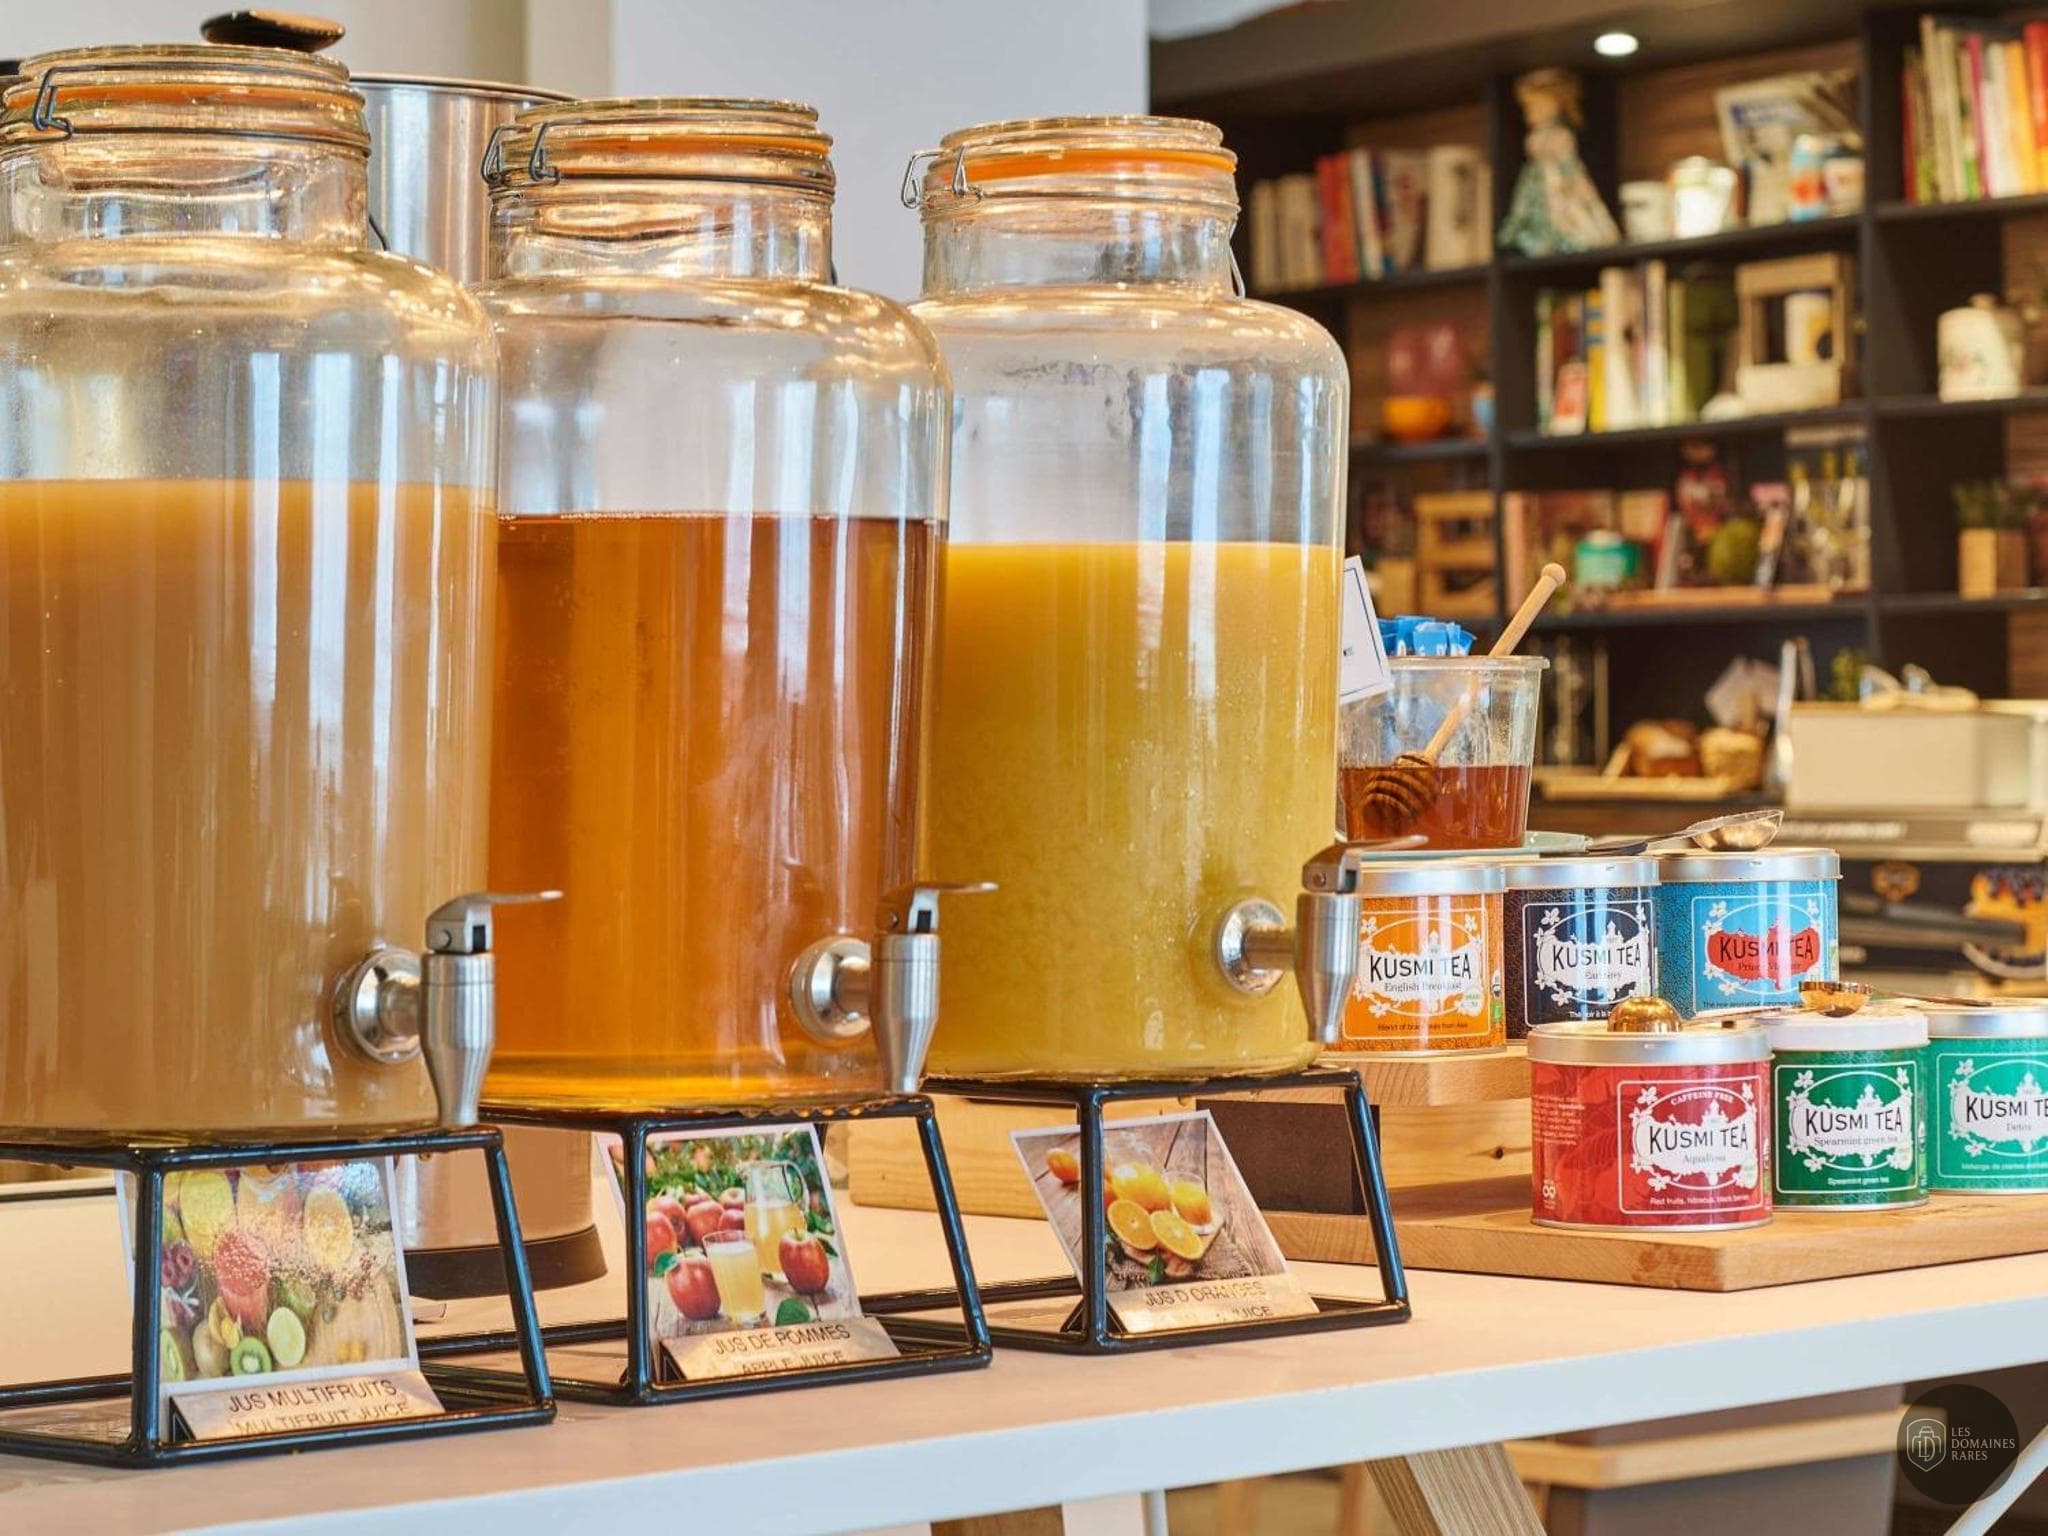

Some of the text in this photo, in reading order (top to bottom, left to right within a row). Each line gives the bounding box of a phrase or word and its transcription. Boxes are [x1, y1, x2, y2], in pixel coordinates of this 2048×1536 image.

[1370, 953, 1472, 983] KUSMI TEA
[1552, 944, 1641, 971] KUSMI TEA
[1384, 981, 1420, 993] English
[1805, 1106, 1903, 1137] KUSMI TEA
[1966, 1095, 2048, 1123] KUSMI TE
[1649, 1123, 1749, 1155] KUSMI TEA
[1814, 1137, 1861, 1148] Spearmint
[1145, 1289, 1175, 1307] JUS
[715, 1324, 850, 1355] JUS DE POMMES
[228, 1379, 398, 1413] JUS MULTIFRUITS
[357, 1400, 411, 1421] JUICE
